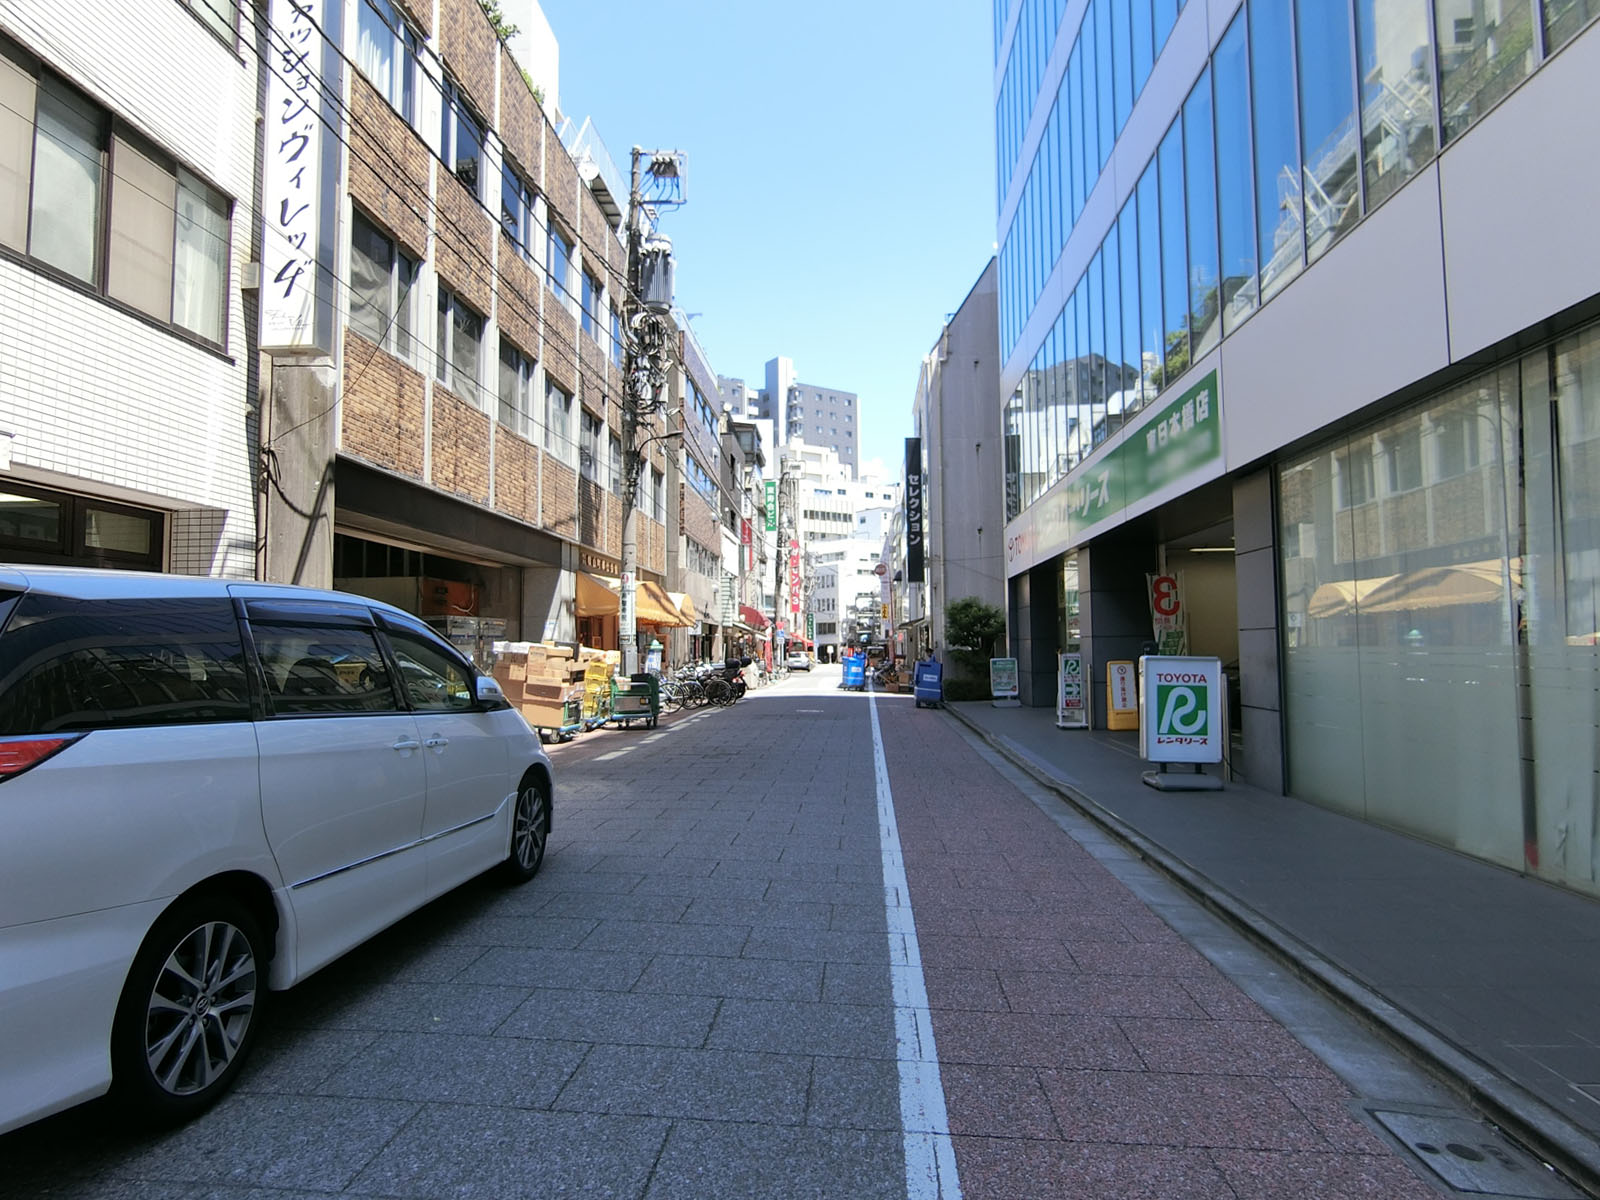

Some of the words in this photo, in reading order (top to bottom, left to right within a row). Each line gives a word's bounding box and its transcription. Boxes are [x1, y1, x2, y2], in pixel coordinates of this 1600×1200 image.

[1146, 389, 1209, 455] 東日本橋店
[907, 474, 921, 545] セレクション
[1156, 673, 1207, 683] TOYOTA
[1157, 737, 1208, 746] レンタリース
